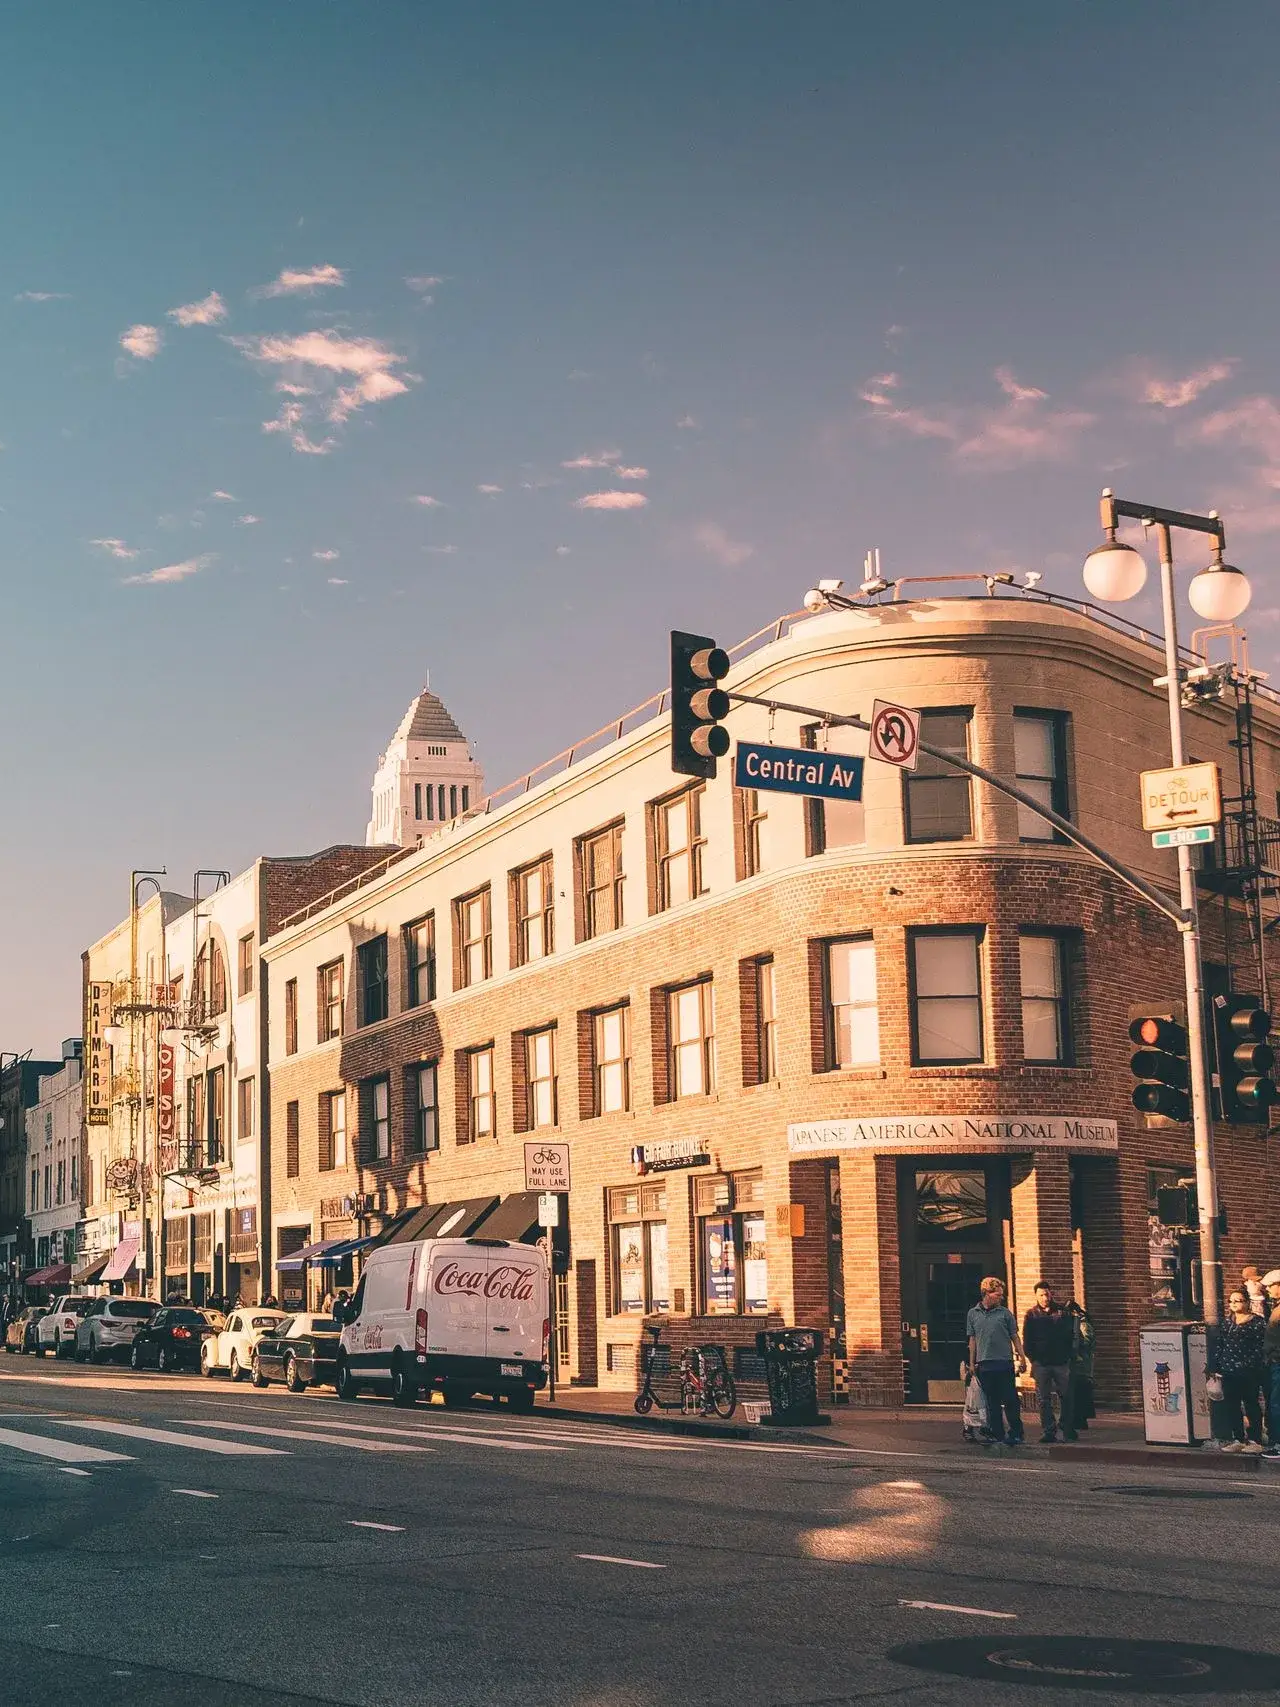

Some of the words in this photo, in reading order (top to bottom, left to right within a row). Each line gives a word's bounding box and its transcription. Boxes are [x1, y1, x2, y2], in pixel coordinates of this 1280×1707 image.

[745, 752, 825, 785] Central
[829, 763, 855, 788] Av
[1149, 790, 1209, 808] DETOUR
[92, 985, 102, 1105] DAIMARU
[792, 1127, 847, 1147] JAPANESE
[854, 1123, 955, 1141] AMERICAN
[964, 1119, 1057, 1139] NATIONAL
[1063, 1120, 1115, 1142] MUSEUM
[529, 1178, 546, 1186] FULL
[532, 1167, 546, 1175] MAY
[550, 1168, 563, 1176] USE
[434, 1262, 538, 1300] Coca-Cola
